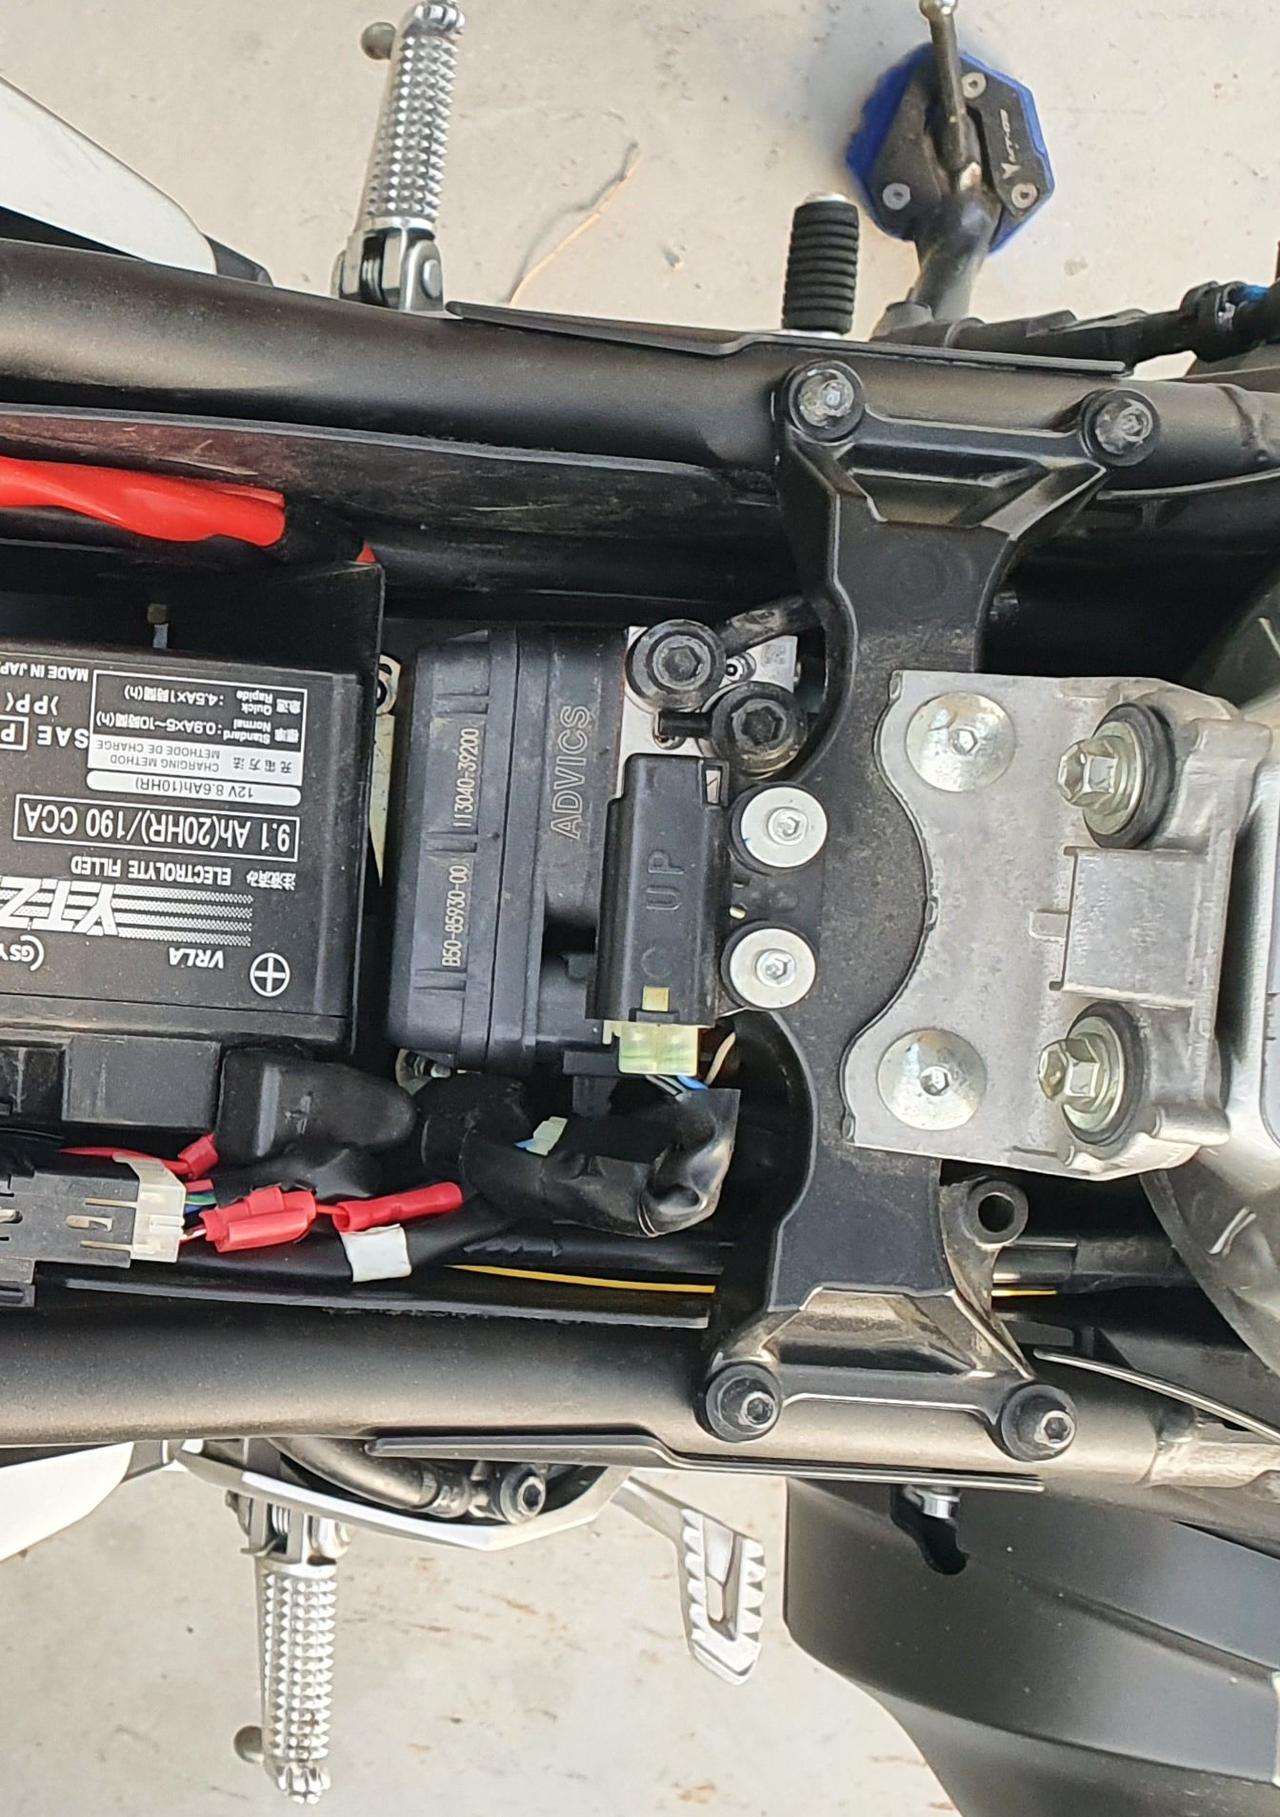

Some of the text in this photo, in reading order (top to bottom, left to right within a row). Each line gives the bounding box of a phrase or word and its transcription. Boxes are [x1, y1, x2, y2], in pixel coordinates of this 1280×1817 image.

[30, 664, 45, 677] IN
[48, 666, 88, 682] MADE
[236, 690, 272, 704] Rapide
[242, 702, 272, 715] Quick
[233, 719, 271, 731] Normal
[36, 726, 89, 749] SAE
[223, 730, 270, 744] Standard
[96, 740, 220, 758] METHODE DE CHARGE
[110, 755, 219, 772] CHARGING METHOD
[550, 704, 591, 840] ADVICS
[453, 727, 479, 828] 113040-39200
[136, 778, 254, 798] 12V 8.6Ah(10HR)
[23, 802, 290, 852] 9.1 Ah(20HR)/190 CCA
[70, 856, 232, 886] ELECTROLYTE FILLED
[645, 849, 684, 912] UP
[442, 864, 469, 967] B50-85930-00
[168, 946, 225, 969] VRLA
